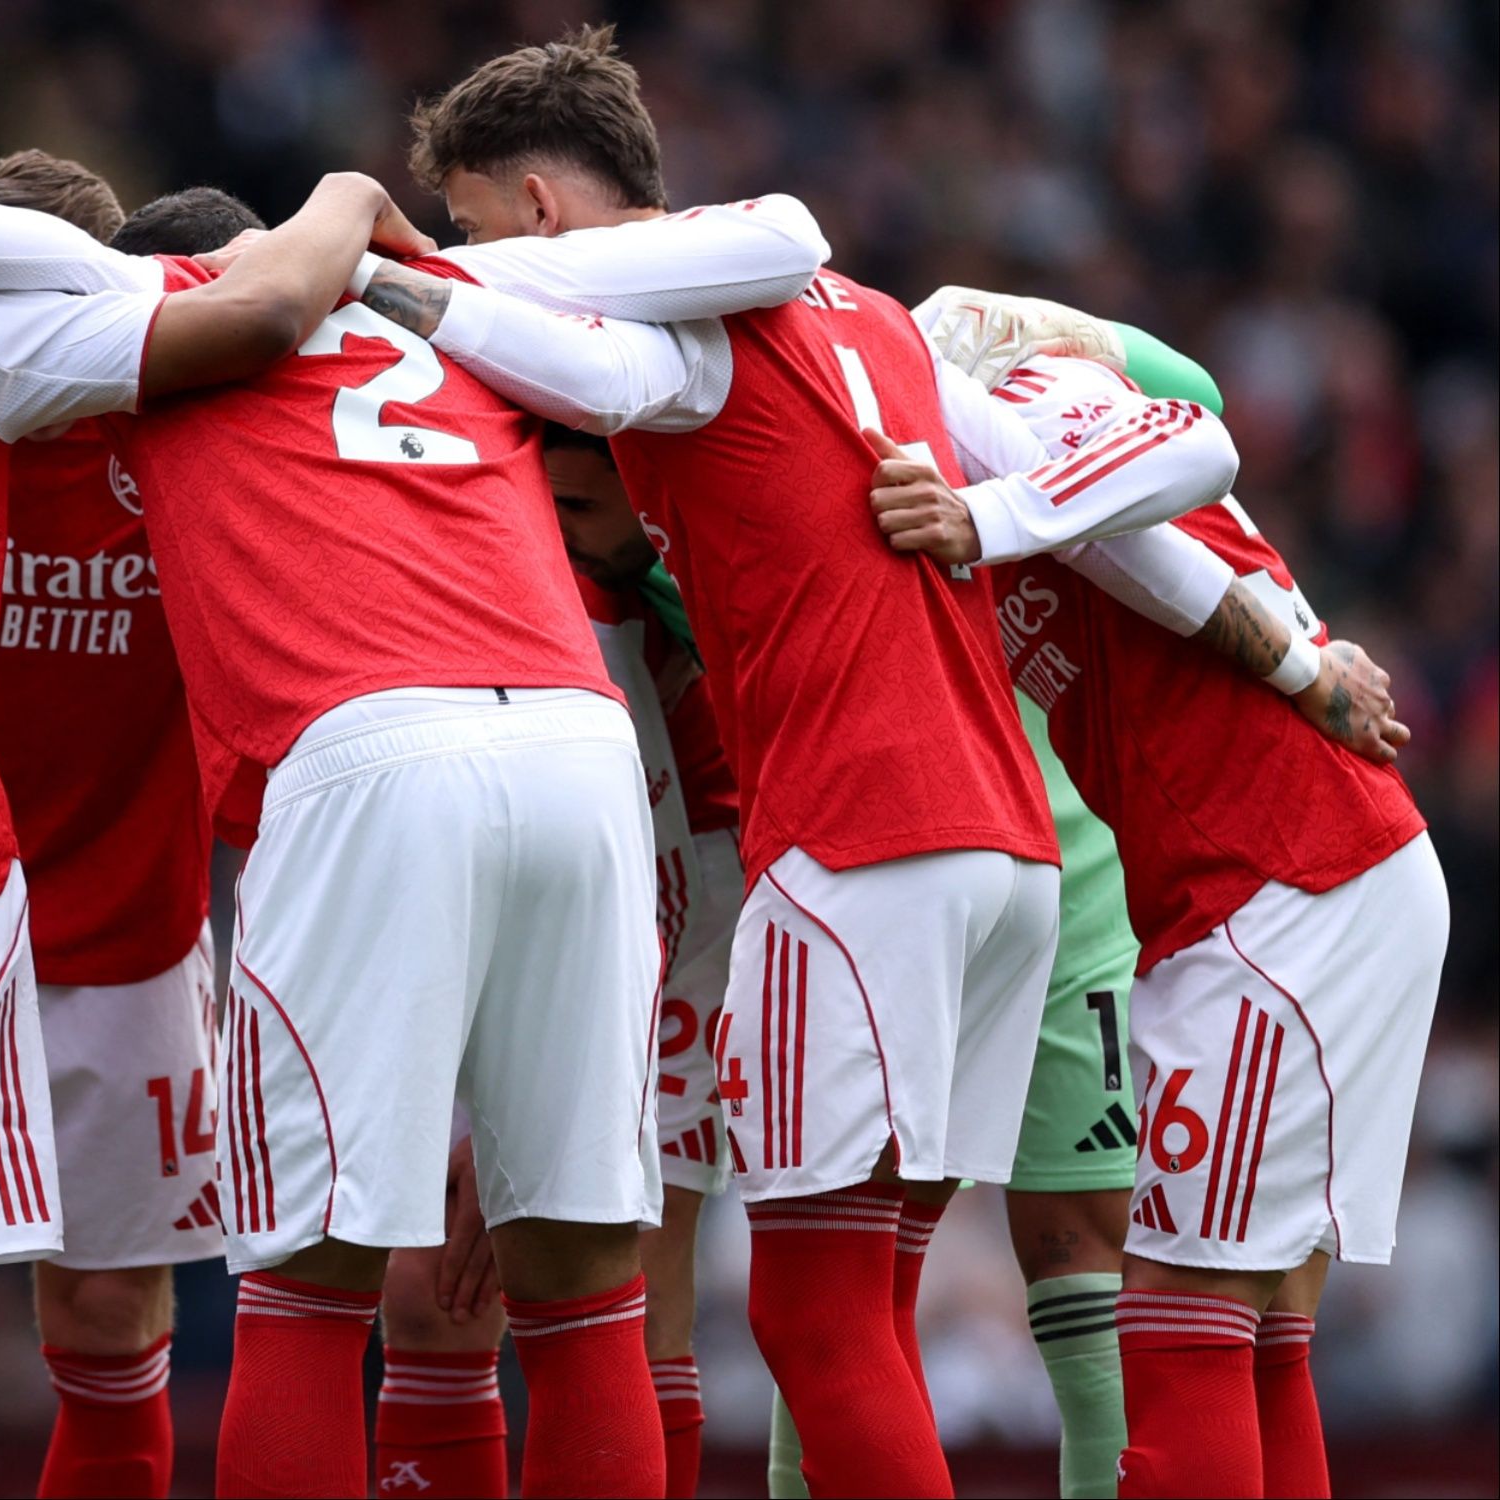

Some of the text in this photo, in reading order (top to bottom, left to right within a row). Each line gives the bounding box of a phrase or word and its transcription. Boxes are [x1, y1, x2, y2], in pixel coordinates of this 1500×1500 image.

[297, 301, 483, 466] 2
[0, 603, 133, 655] BETTER
[715, 1013, 748, 1117] 4
[1086, 991, 1122, 1090] 1
[147, 1067, 218, 1178] 14
